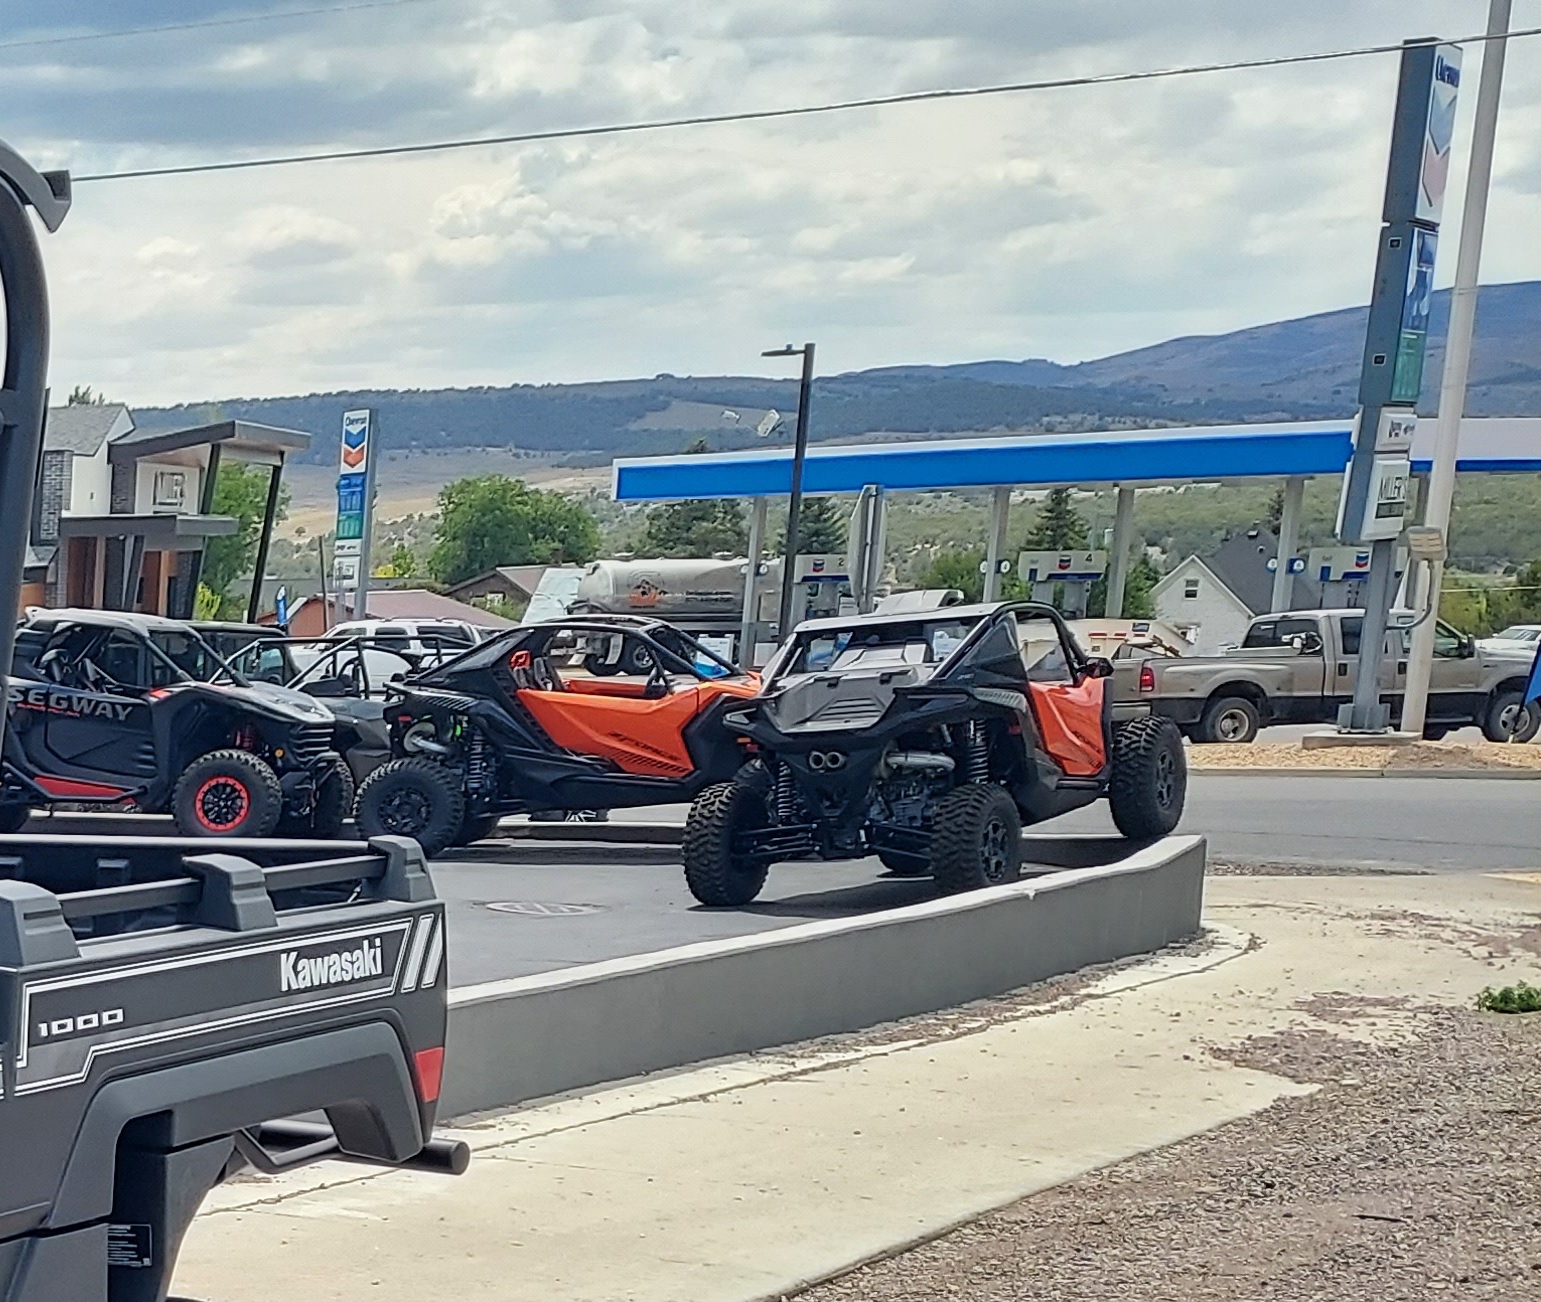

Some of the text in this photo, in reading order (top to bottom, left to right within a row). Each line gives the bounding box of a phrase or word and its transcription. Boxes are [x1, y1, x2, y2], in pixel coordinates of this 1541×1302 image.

[7, 685, 134, 722] SEGWAY
[279, 937, 384, 993] Kawasaki
[37, 1008, 125, 1038] 1000
